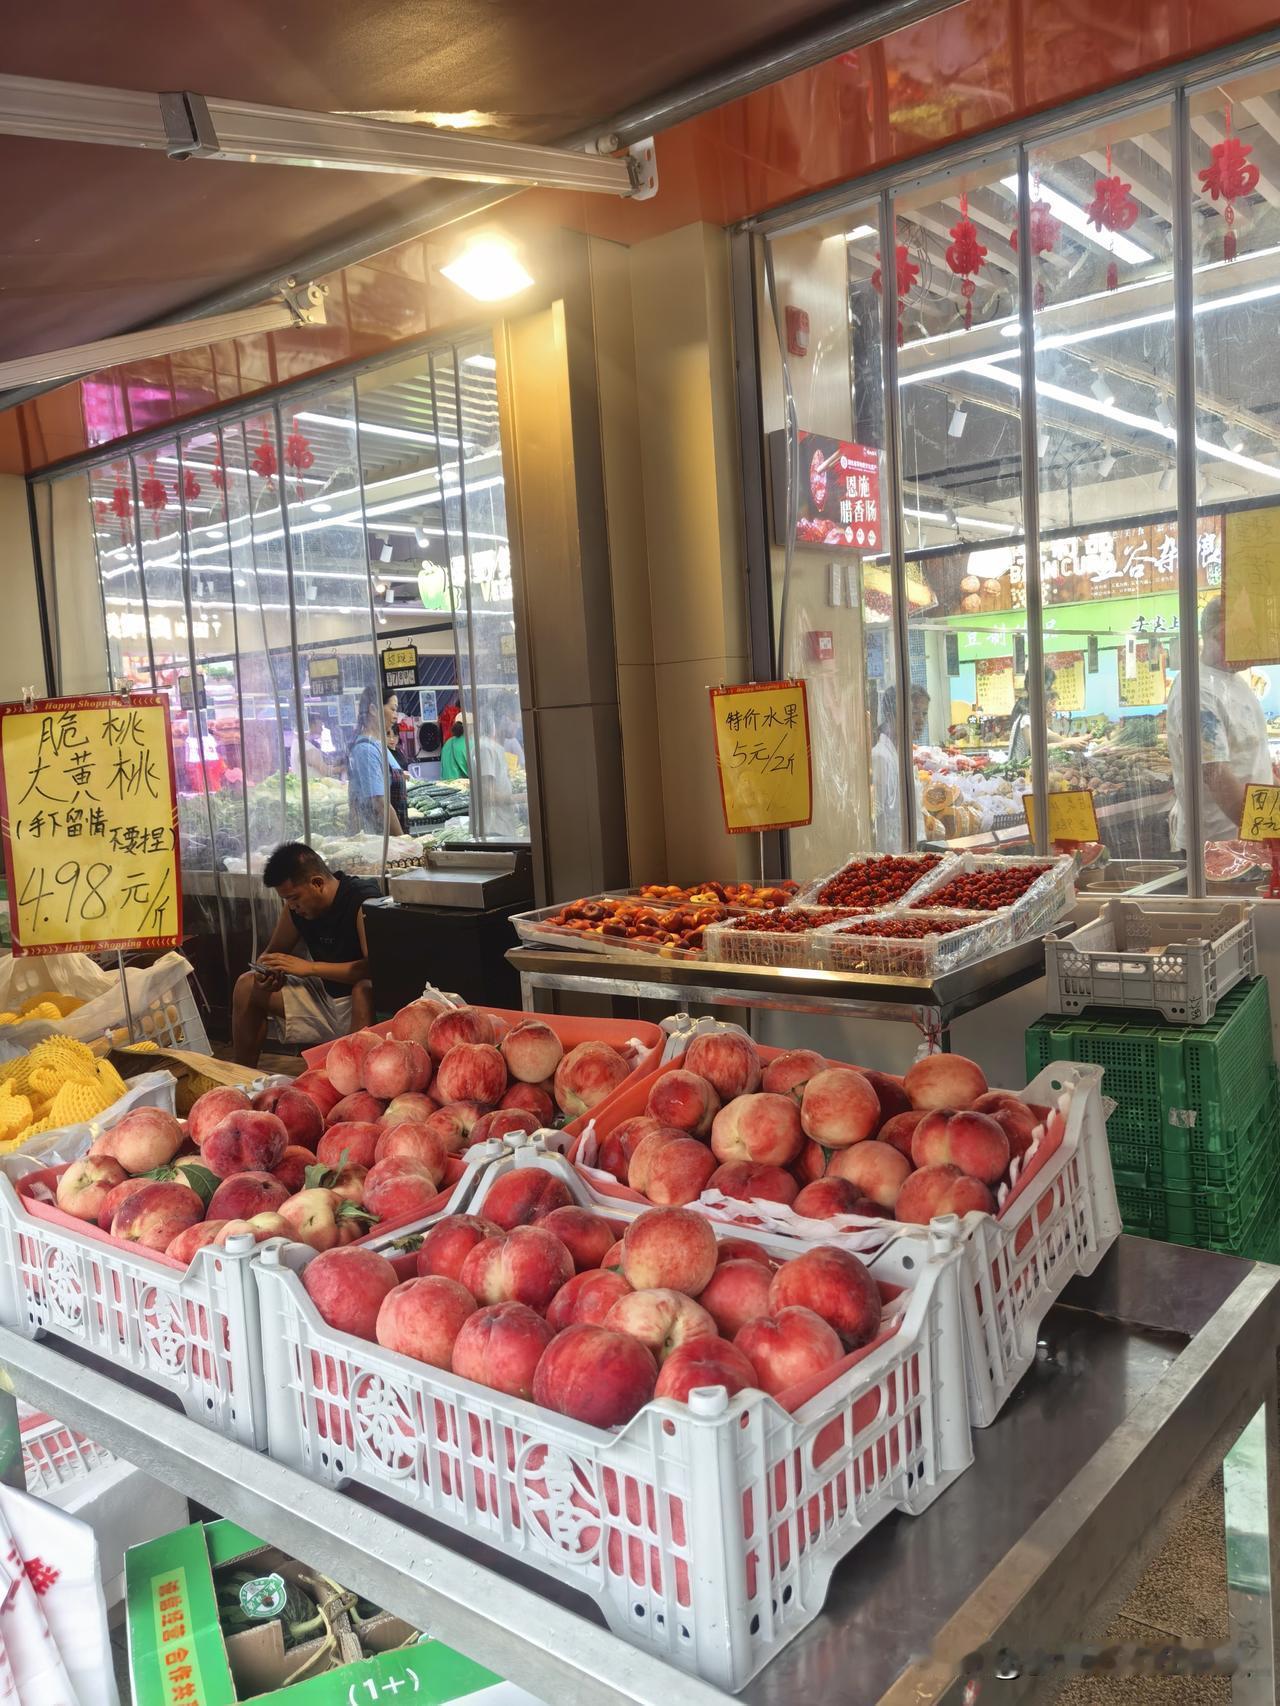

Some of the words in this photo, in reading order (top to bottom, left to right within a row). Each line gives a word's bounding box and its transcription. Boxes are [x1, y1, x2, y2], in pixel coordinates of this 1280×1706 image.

[846, 474, 870, 498] 恩施
[840, 499, 877, 523] 腊香肠
[45, 700, 76, 710] Happy
[726, 704, 798, 731] 特价水果
[731, 732, 795, 775] 5元/2斤
[18, 747, 160, 806] 大黄桃
[64, 942, 97, 952] Happy
[99, 938, 142, 950] Shopping
[349, 1667, 420, 1706] (1+)
